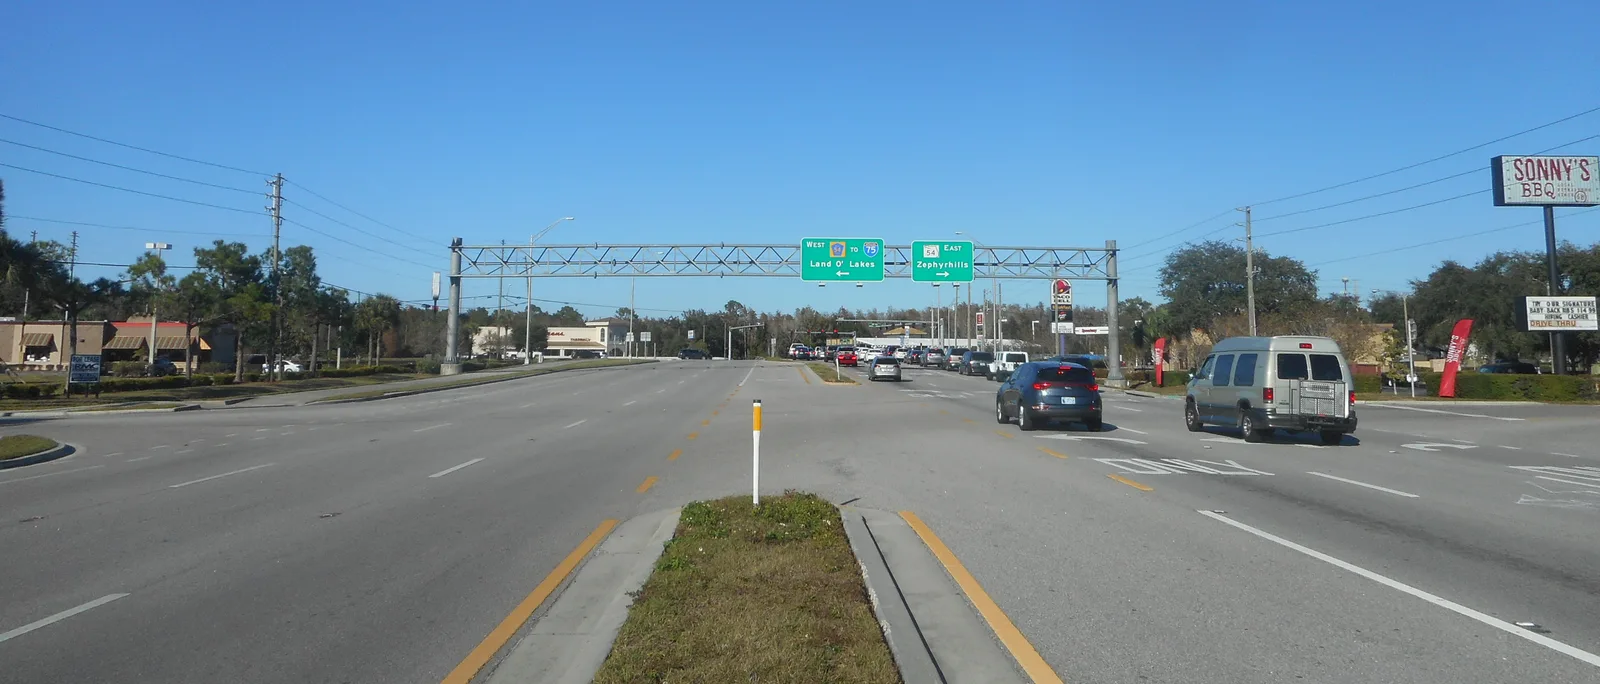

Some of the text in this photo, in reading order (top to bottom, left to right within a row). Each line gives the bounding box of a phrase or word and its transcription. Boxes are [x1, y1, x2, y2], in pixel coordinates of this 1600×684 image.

[1514, 158, 1590, 181] SONNY'S
[1521, 182, 1556, 199] BBQ
[866, 245, 876, 253] 75
[849, 260, 875, 268] Lakes
[916, 260, 969, 269] Zephyrhills
[1446, 335, 1459, 363] SONNY'S
